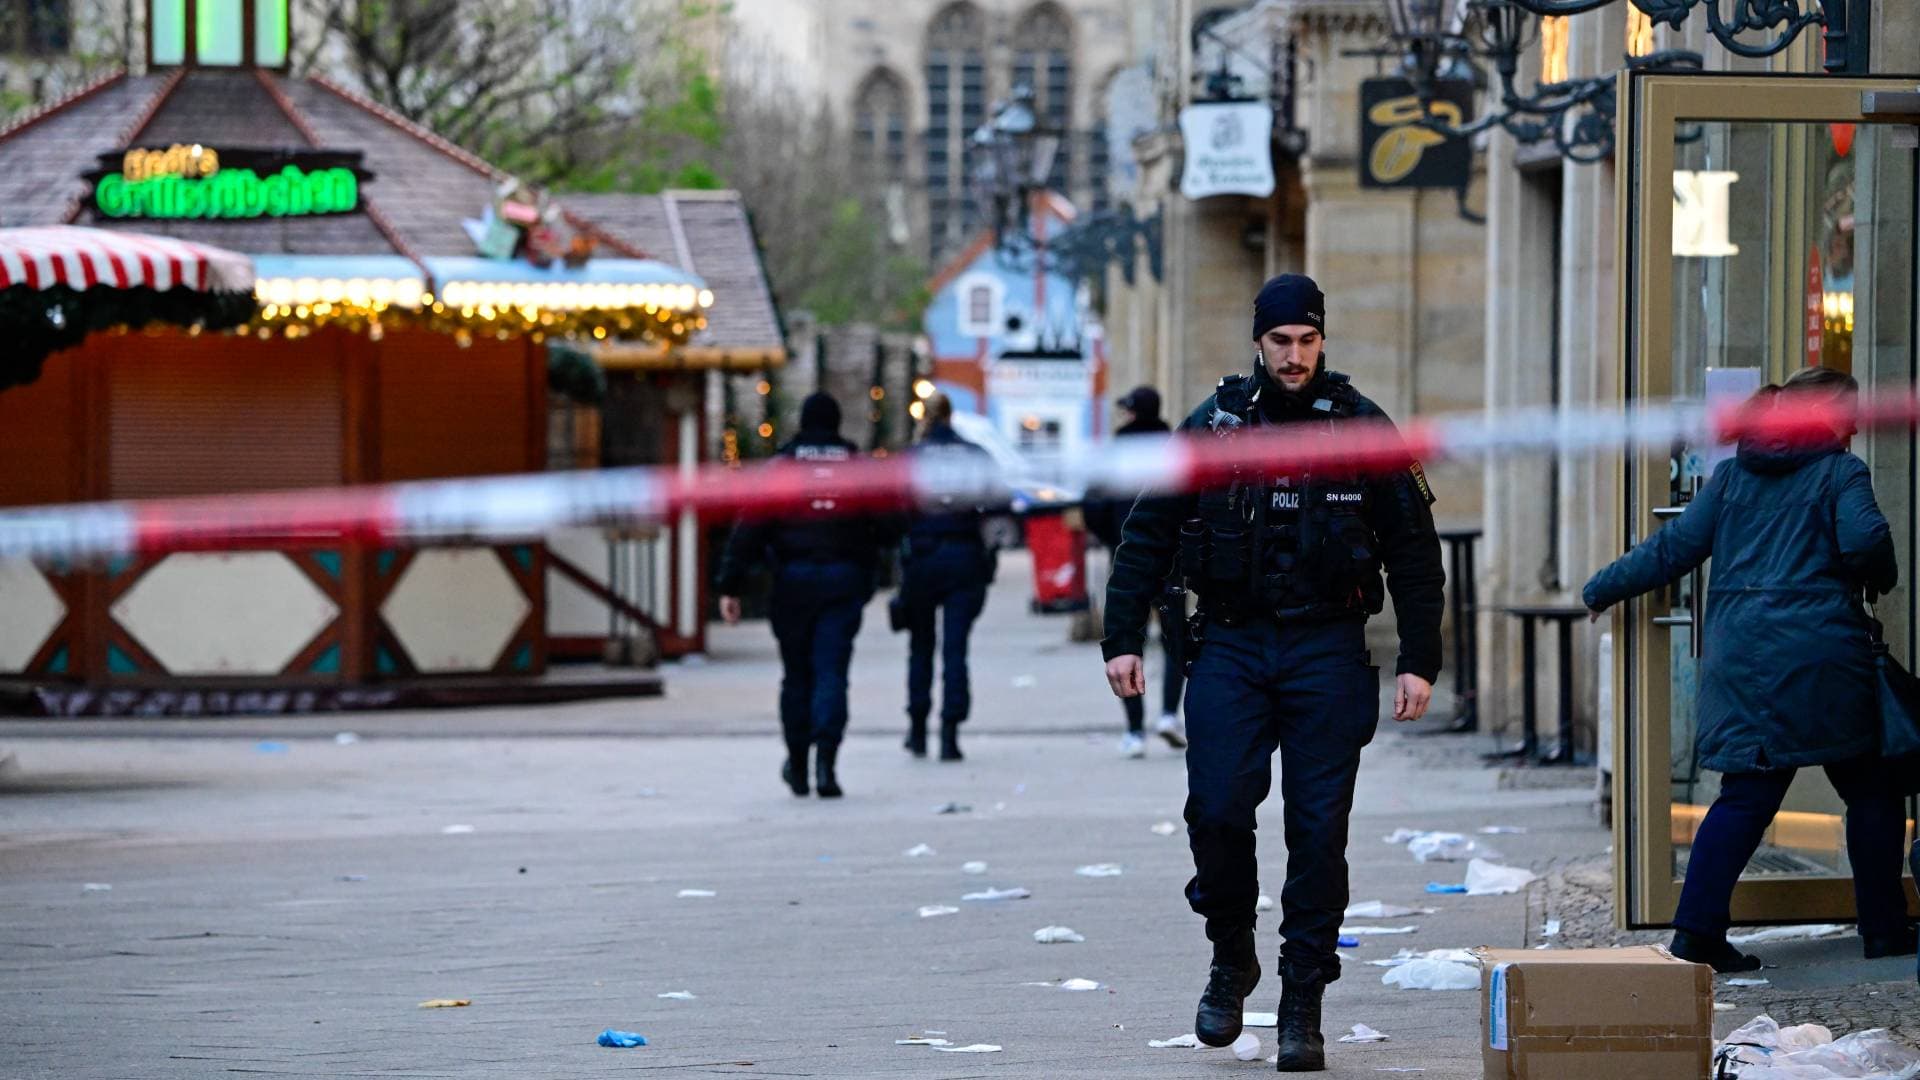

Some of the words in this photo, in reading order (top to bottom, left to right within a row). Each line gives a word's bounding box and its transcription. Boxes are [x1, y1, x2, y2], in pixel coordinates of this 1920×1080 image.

[1272, 491, 1299, 508] POLIZ
[1326, 493, 1339, 501] SN
[1340, 493, 1362, 501] 64000
